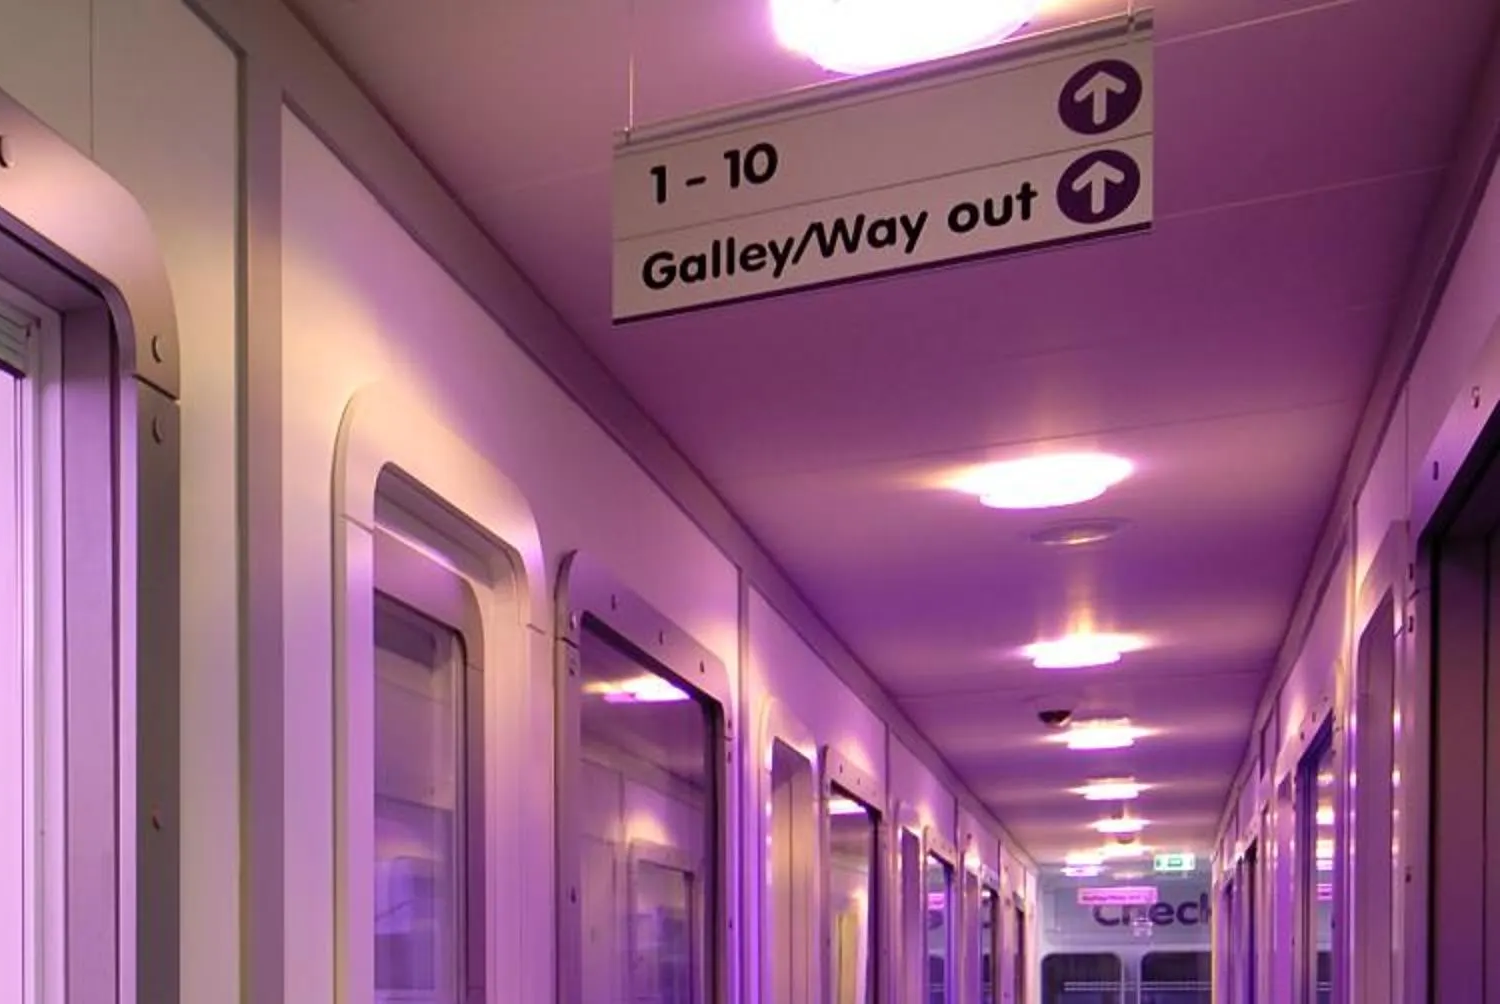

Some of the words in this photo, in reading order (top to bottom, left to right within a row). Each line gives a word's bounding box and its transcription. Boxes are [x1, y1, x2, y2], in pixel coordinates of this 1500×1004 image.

[649, 164, 667, 205] 1
[723, 142, 779, 189] 10
[641, 211, 929, 291] Galley/Way
[947, 181, 1039, 234] out
